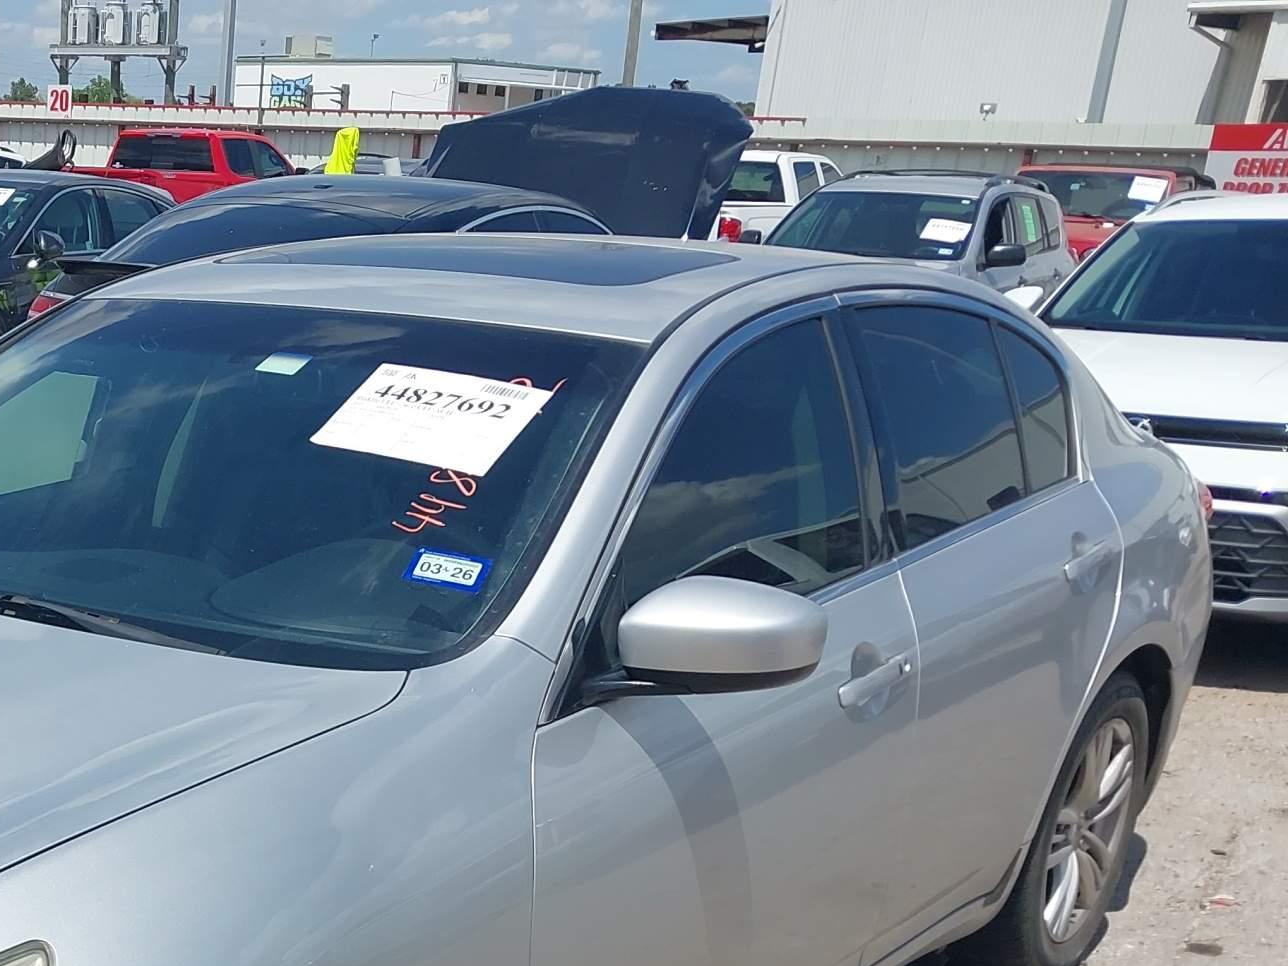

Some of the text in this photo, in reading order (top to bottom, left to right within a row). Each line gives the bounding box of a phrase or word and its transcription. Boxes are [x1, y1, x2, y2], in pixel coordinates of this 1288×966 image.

[50, 89, 69, 112] 20
[374, 383, 512, 420] 44827692
[419, 561, 475, 581] 03 26
